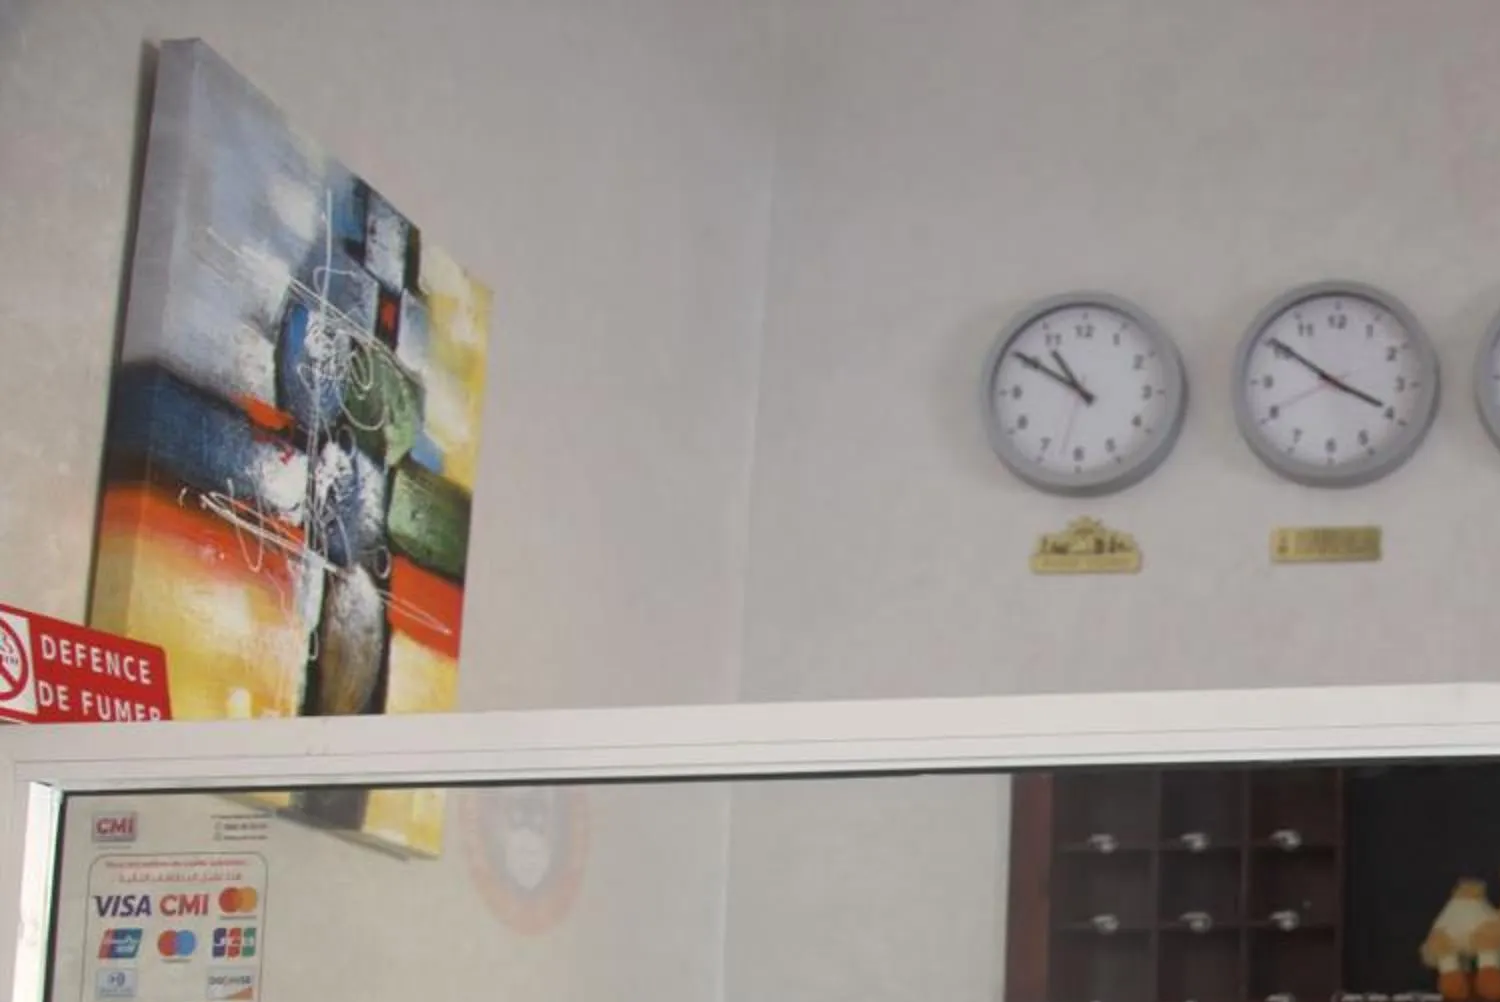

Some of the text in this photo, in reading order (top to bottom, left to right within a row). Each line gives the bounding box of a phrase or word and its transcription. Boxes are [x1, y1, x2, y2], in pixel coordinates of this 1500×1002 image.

[1328, 314, 1347, 329] 12
[1075, 324, 1095, 338] 12
[1298, 323, 1313, 336] 11
[1366, 324, 1373, 338] 1
[1045, 333, 1062, 346] 11
[1113, 333, 1120, 346] 1
[1293, 428, 1302, 443] 7
[1040, 437, 1051, 451] 7
[40, 633, 152, 685] DEFENCE
[38, 680, 70, 711] DE
[96, 816, 134, 834] CMI
[94, 893, 209, 917] VISA CMI
